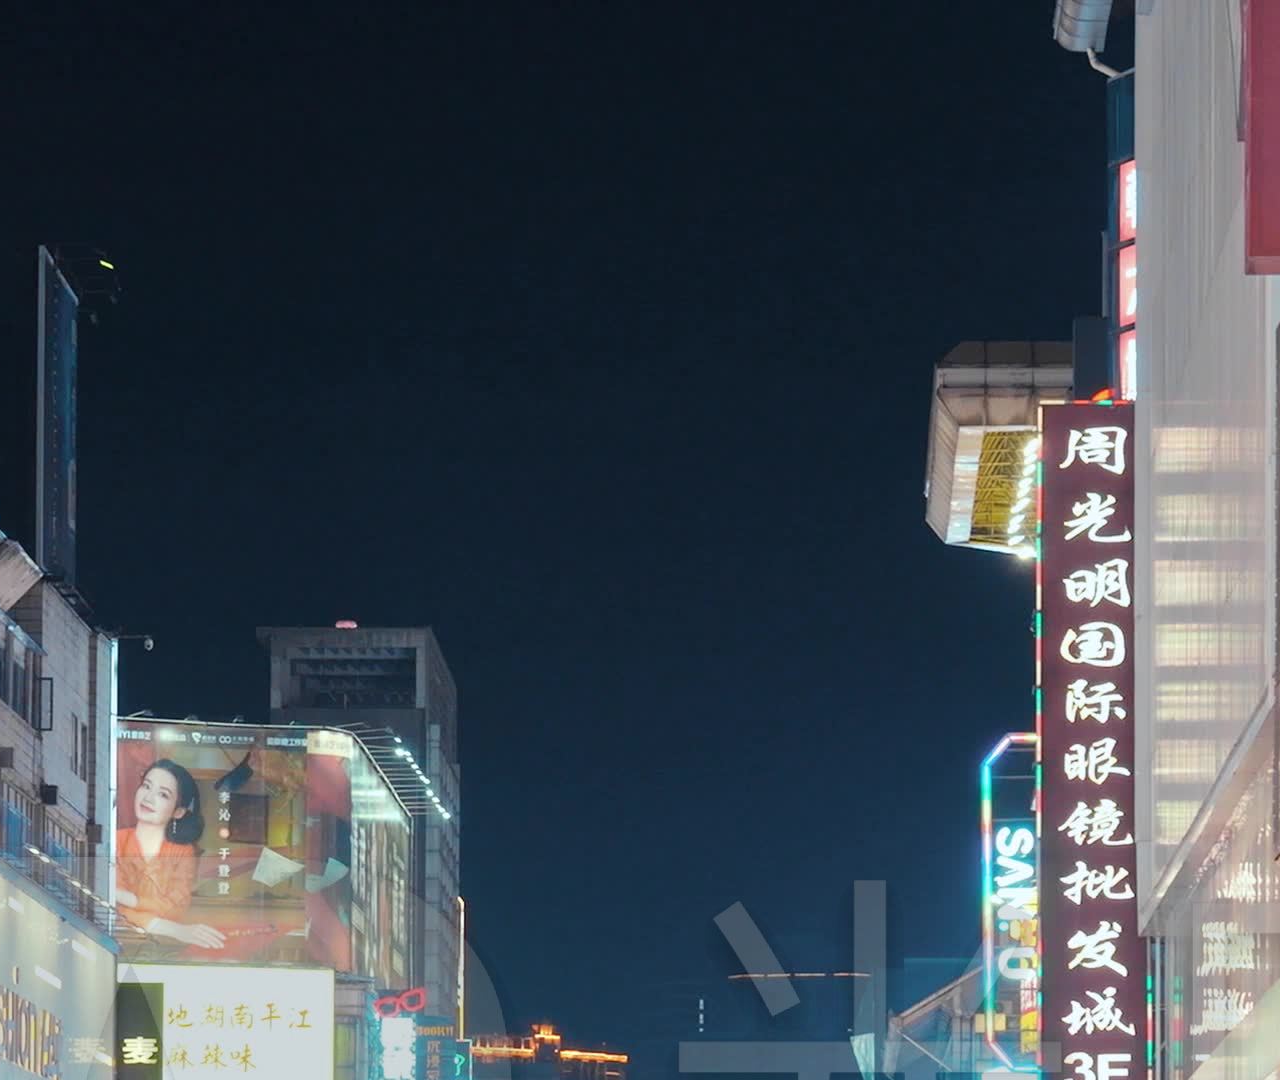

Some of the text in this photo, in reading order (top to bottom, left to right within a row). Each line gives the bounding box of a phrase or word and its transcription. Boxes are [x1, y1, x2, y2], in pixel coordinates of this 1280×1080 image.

[1058, 426, 1136, 1037] 周光明国际眼镜批发城
